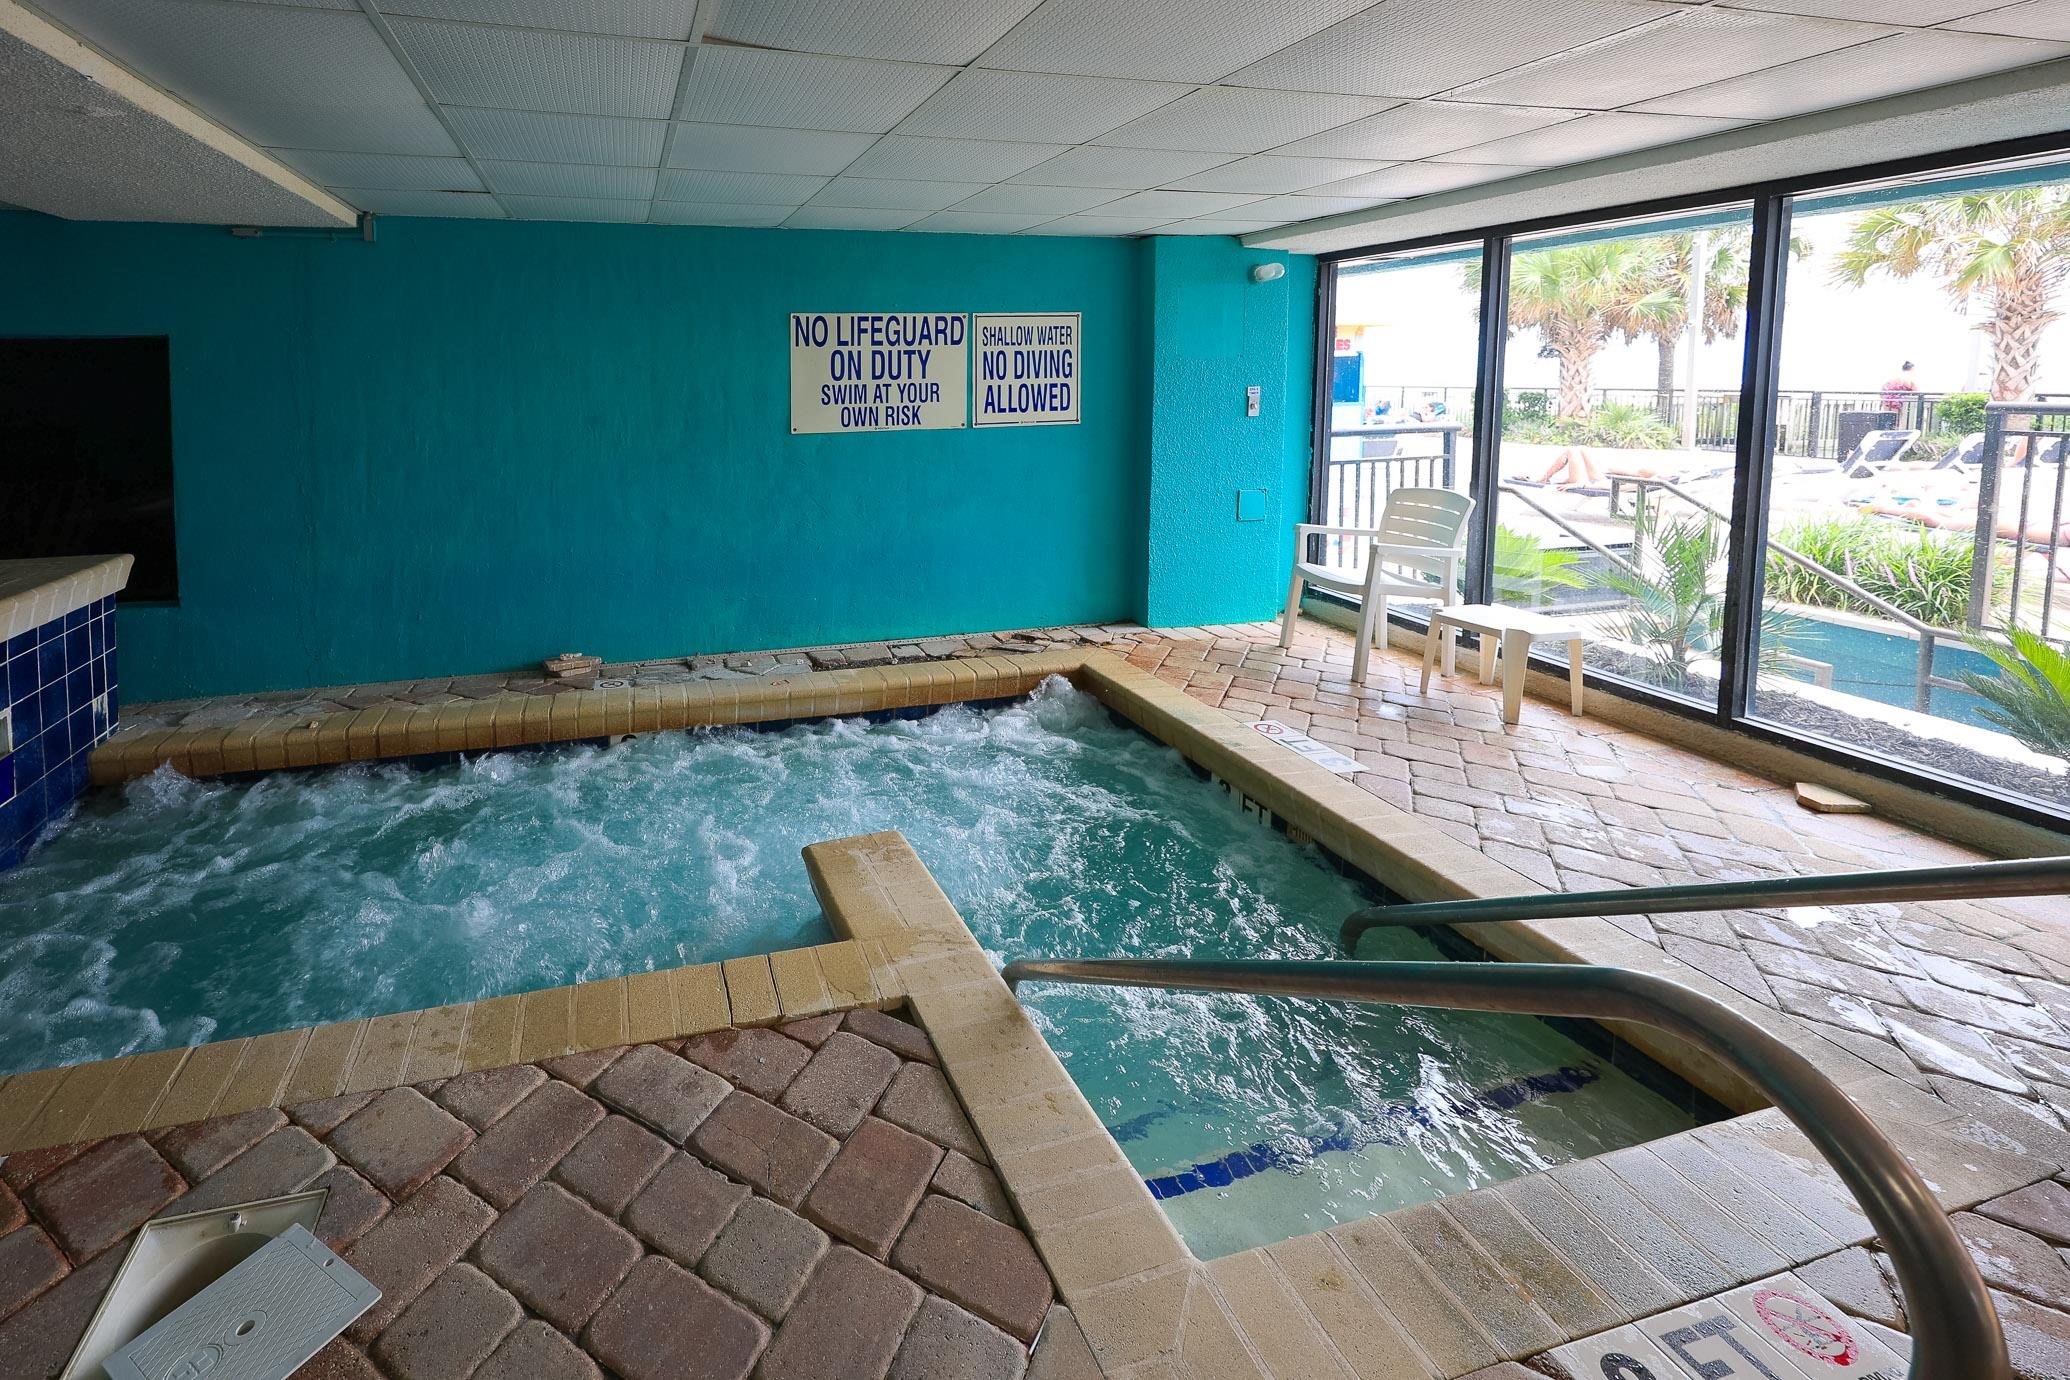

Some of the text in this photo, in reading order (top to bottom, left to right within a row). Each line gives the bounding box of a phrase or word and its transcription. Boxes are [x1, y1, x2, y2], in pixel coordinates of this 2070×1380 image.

[795, 315, 965, 347] NO LIFEGUARD
[982, 325, 1073, 347] SHALLOW WATER
[830, 349, 932, 381] ON DUTY
[983, 348, 1073, 381] NO DIVING
[821, 382, 940, 405] SWIM AT YOUR
[983, 382, 1071, 414] ALLOWED
[840, 405, 922, 427] OWN RISK
